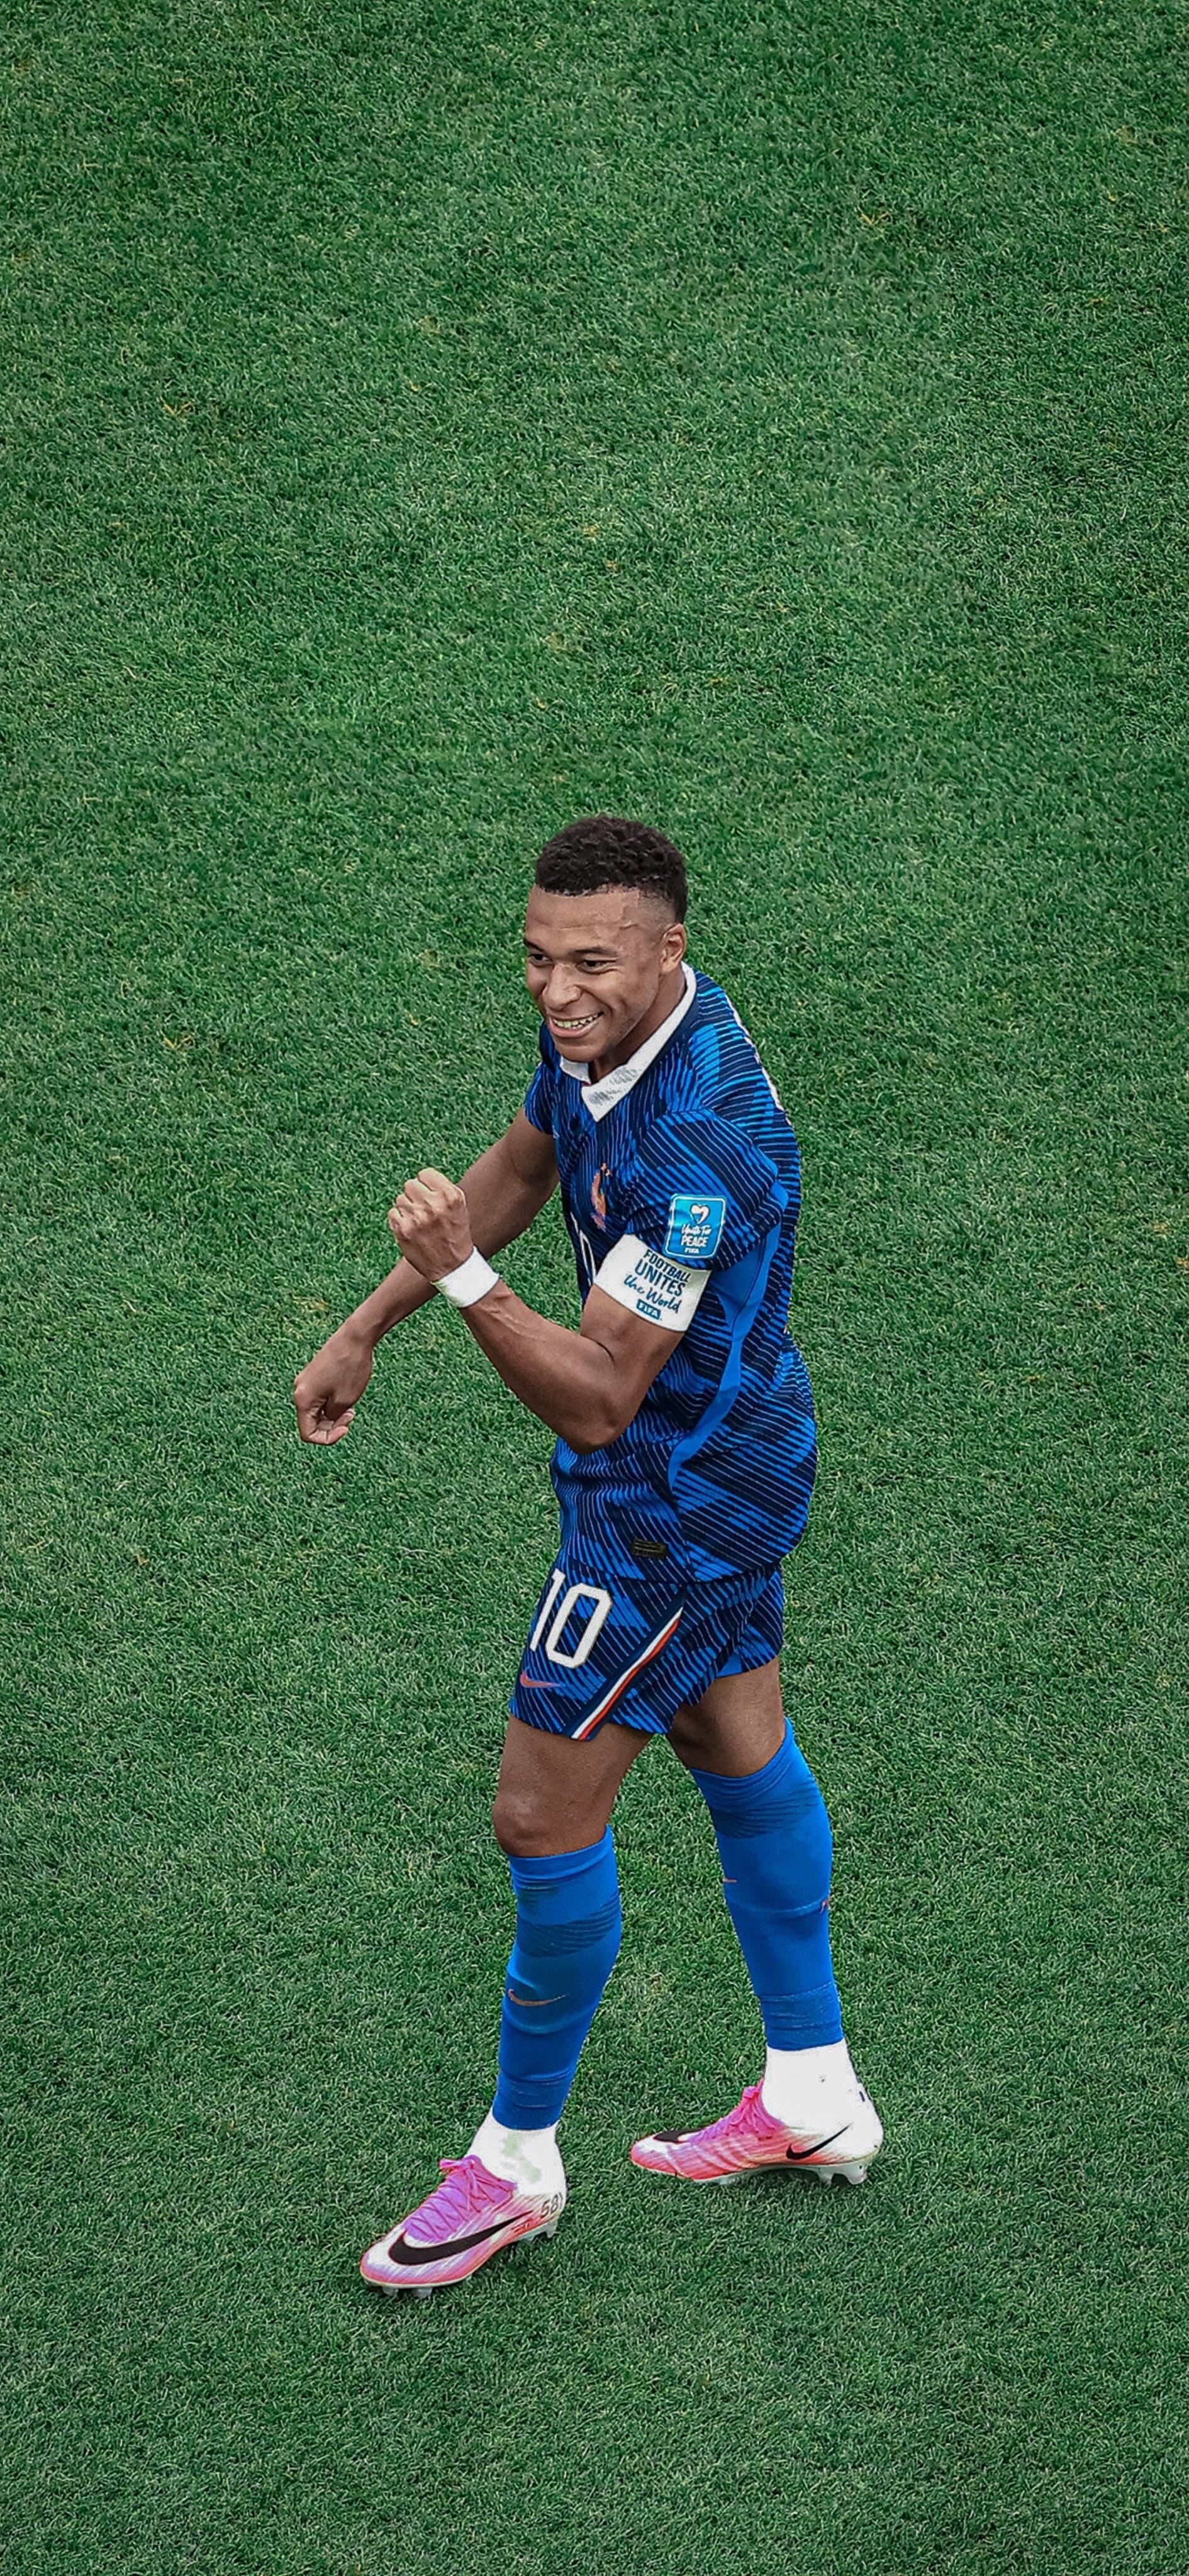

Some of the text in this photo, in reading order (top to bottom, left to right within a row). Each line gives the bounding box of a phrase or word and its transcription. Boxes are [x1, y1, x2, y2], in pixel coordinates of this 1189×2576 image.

[681, 1235, 709, 1248] PEACE
[635, 1258, 686, 1297] UNITES
[643, 1248, 691, 1282] FOOTBALL
[623, 1274, 682, 1314] the World
[637, 1301, 659, 1318] FIFA
[530, 1568, 613, 1669] 10
